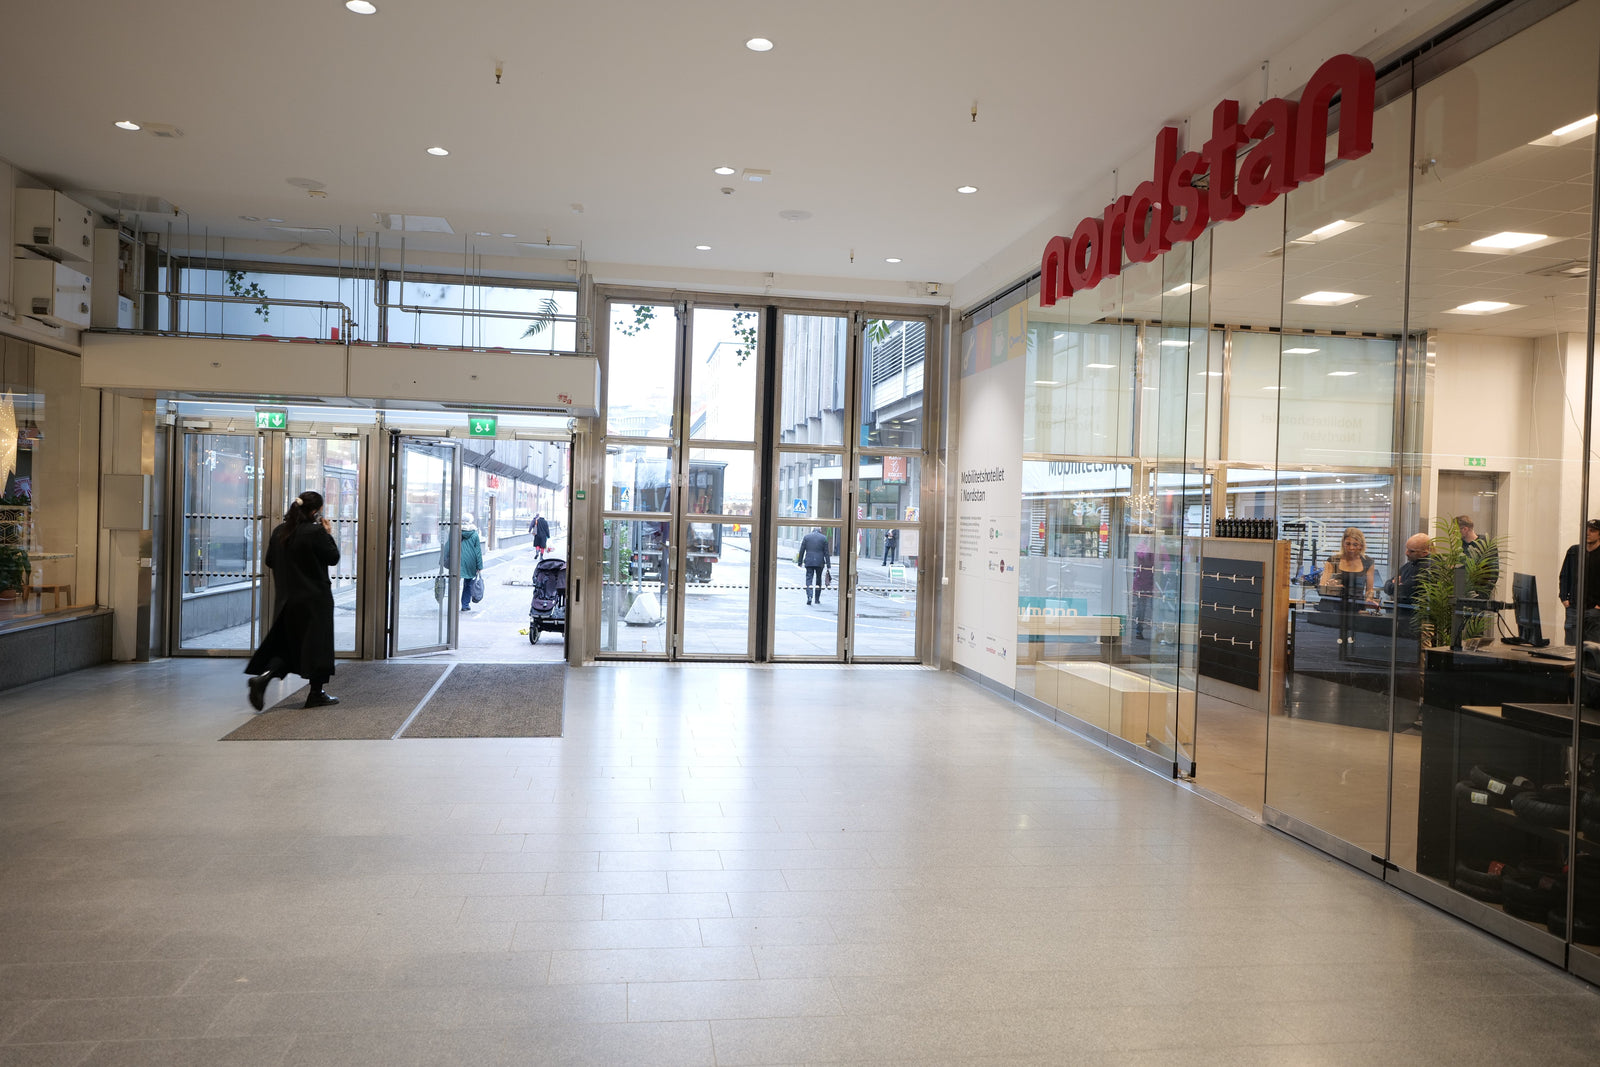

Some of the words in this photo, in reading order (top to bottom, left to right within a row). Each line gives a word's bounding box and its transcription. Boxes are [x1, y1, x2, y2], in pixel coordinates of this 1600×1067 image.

[1040, 54, 1376, 307] nordstan
[961, 467, 1004, 484] Mobilitetshotellet
[963, 488, 985, 502] Nordstan
